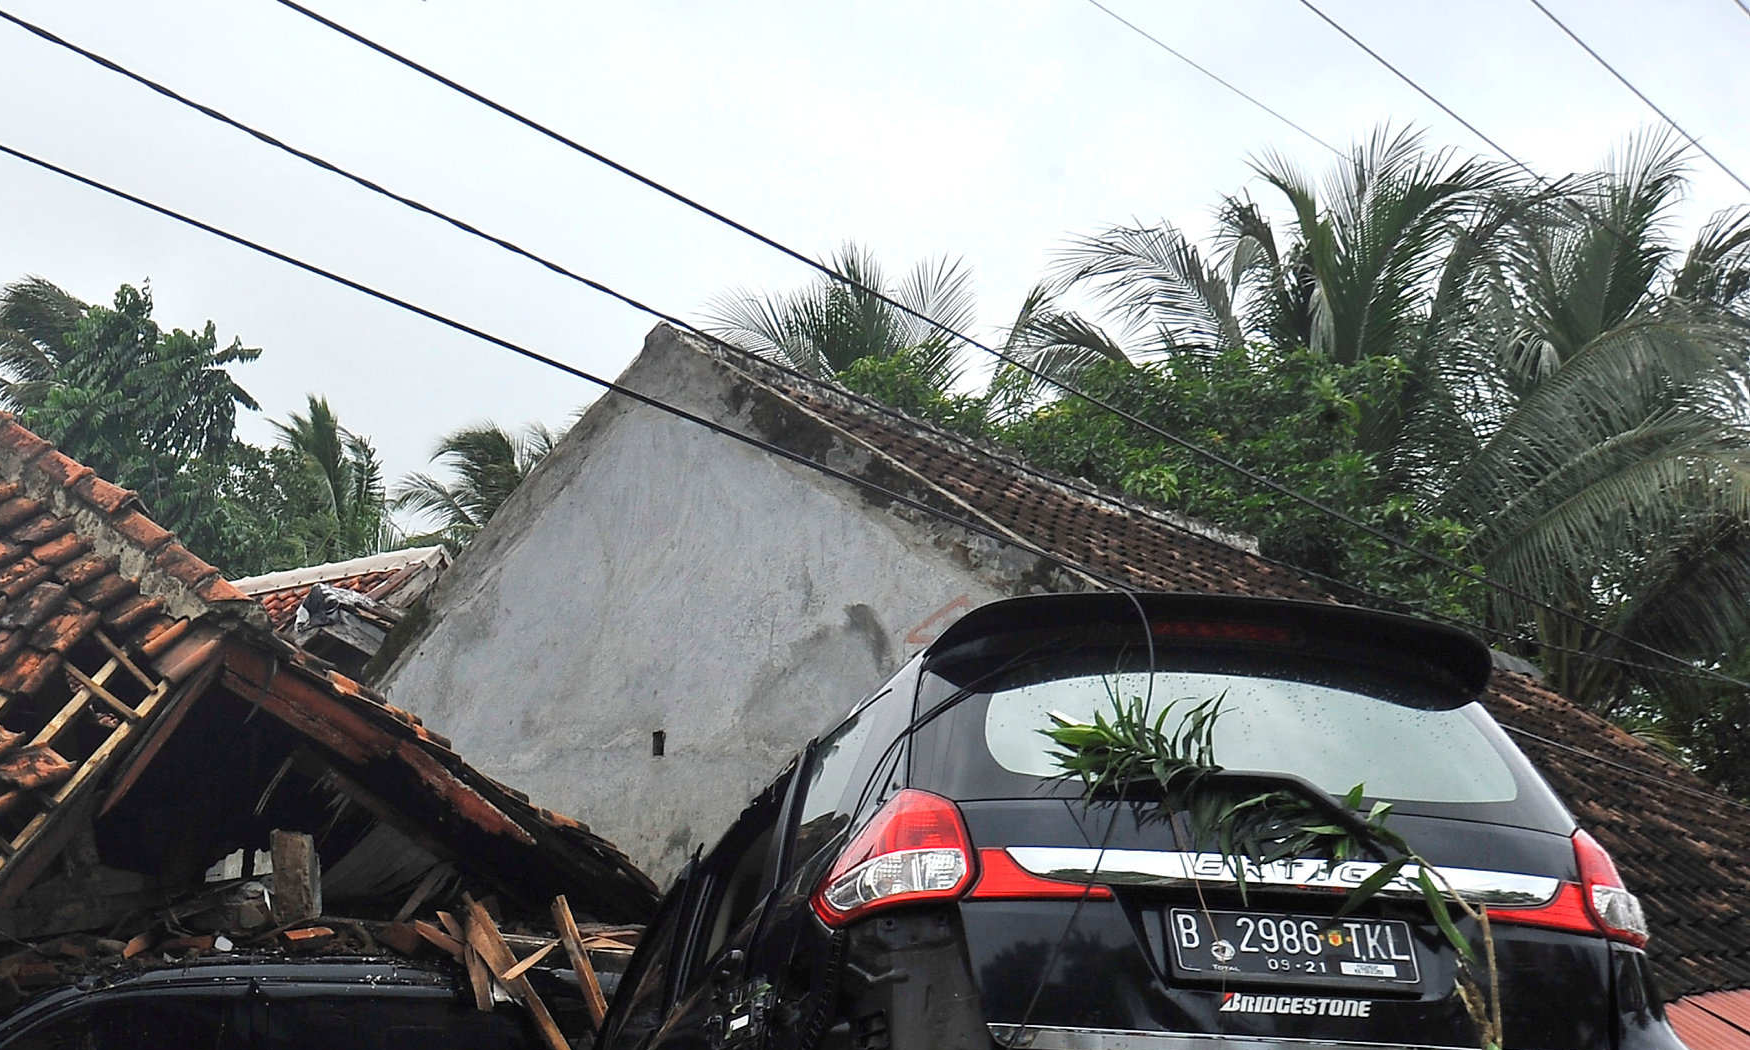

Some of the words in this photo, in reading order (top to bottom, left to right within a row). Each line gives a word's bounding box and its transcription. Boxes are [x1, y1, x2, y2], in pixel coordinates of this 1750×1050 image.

[1177, 914, 1200, 948] B
[1236, 917, 1322, 955] 2986
[1212, 964, 1241, 972] TOTAL
[1220, 992, 1372, 1018] BRIDGESTONE
